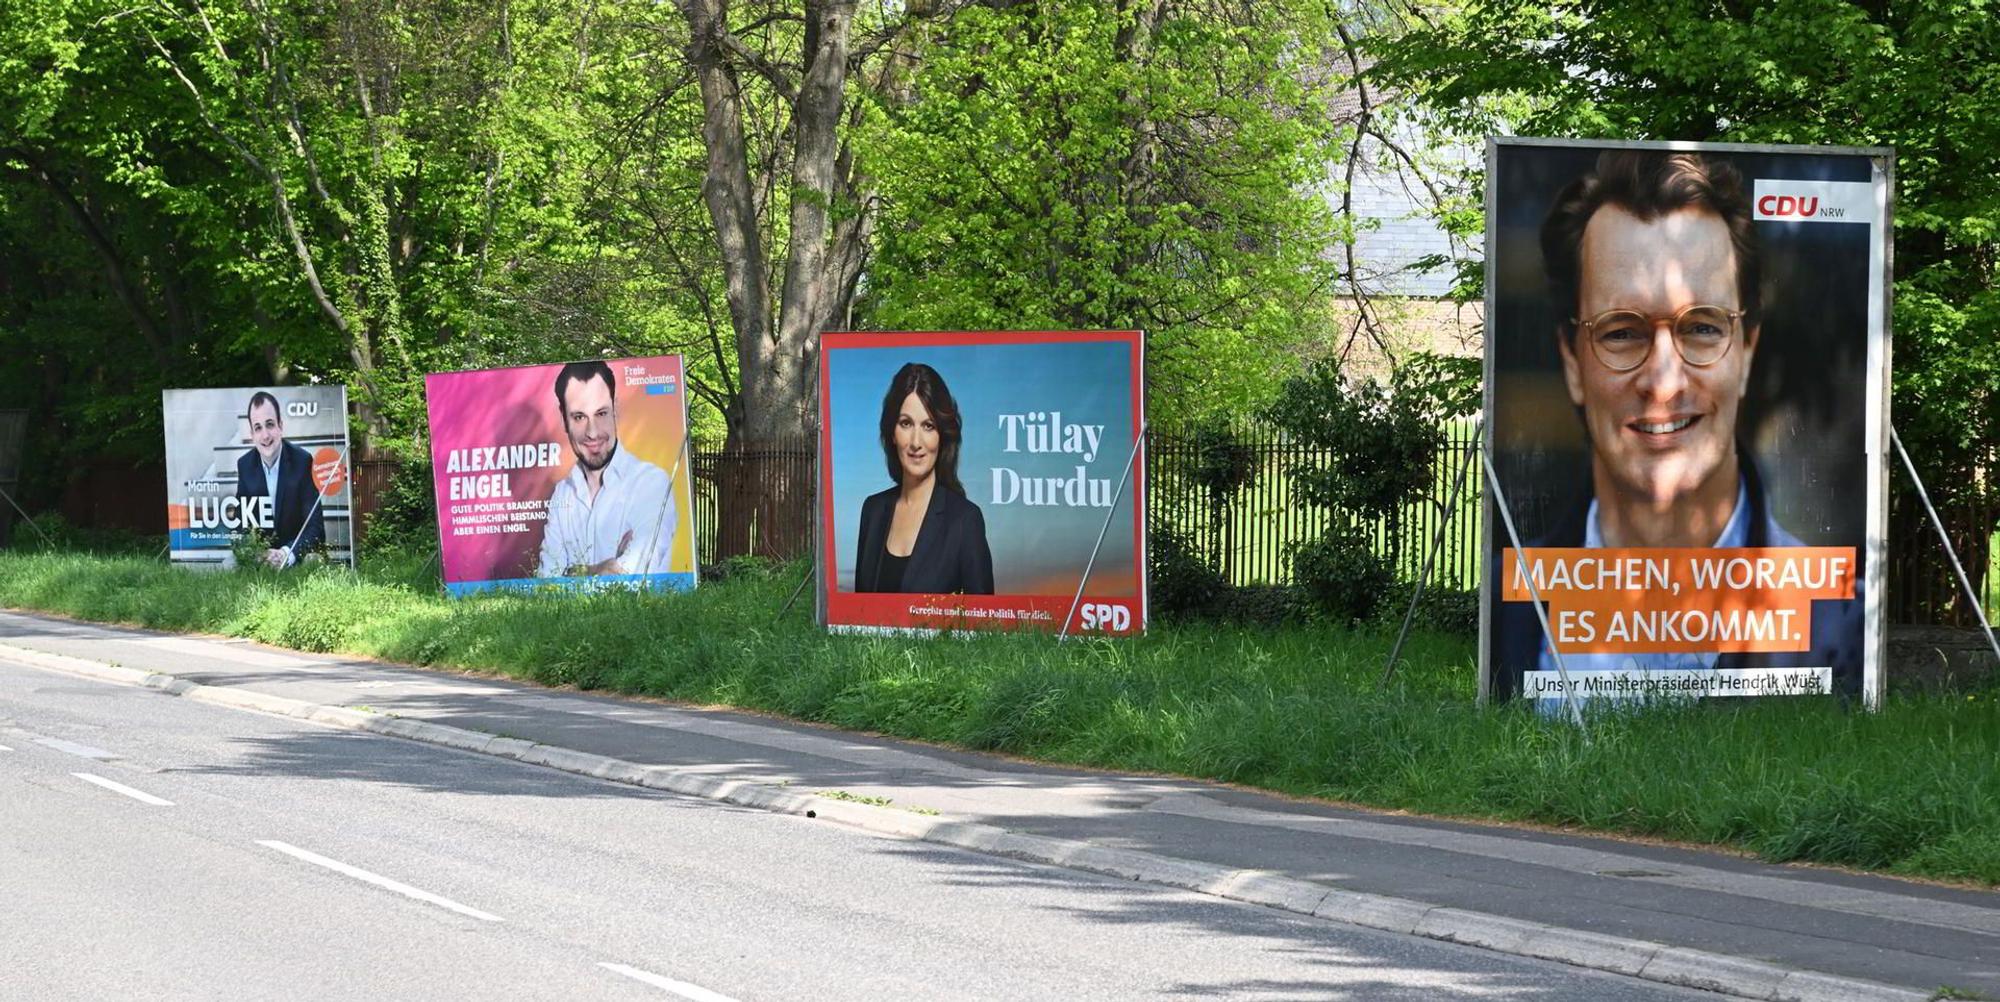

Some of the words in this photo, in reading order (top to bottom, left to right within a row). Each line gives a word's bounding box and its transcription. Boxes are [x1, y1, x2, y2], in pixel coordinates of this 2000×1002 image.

[1758, 195, 1818, 217] CDU
[1820, 208, 1845, 217] NRW
[624, 365, 645, 376] Freie
[625, 374, 676, 386] Demokraten
[287, 402, 318, 417] CDU
[998, 411, 1105, 463] Tülay
[446, 442, 561, 473] ALEXANDER
[187, 480, 219, 492] Martin
[450, 473, 512, 501] ENGEL
[990, 465, 1113, 508] Durdu
[188, 495, 275, 529] LUCKE
[451, 503, 472, 515] GUTE
[474, 501, 505, 513] POLITIK
[506, 500, 542, 511] BRAUCHT
[452, 512, 509, 526] HIMMLISCHEN
[453, 525, 474, 537] ABER
[476, 523, 501, 536] EINEN
[502, 522, 530, 534] ENGEL.
[1513, 558, 1681, 596] MACHEN,
[1690, 557, 1847, 590] WORAUF
[943, 606, 960, 616] und
[988, 608, 1016, 619] Politik
[1017, 608, 1031, 619] für
[1081, 602, 1131, 632] SPD
[1558, 610, 1596, 644] ES
[1605, 609, 1802, 643] ANKOMMT.
[1584, 675, 1715, 695] Ministerpräsident
[1719, 673, 1779, 690] Hendrik
[1785, 672, 1821, 689] Wüst
